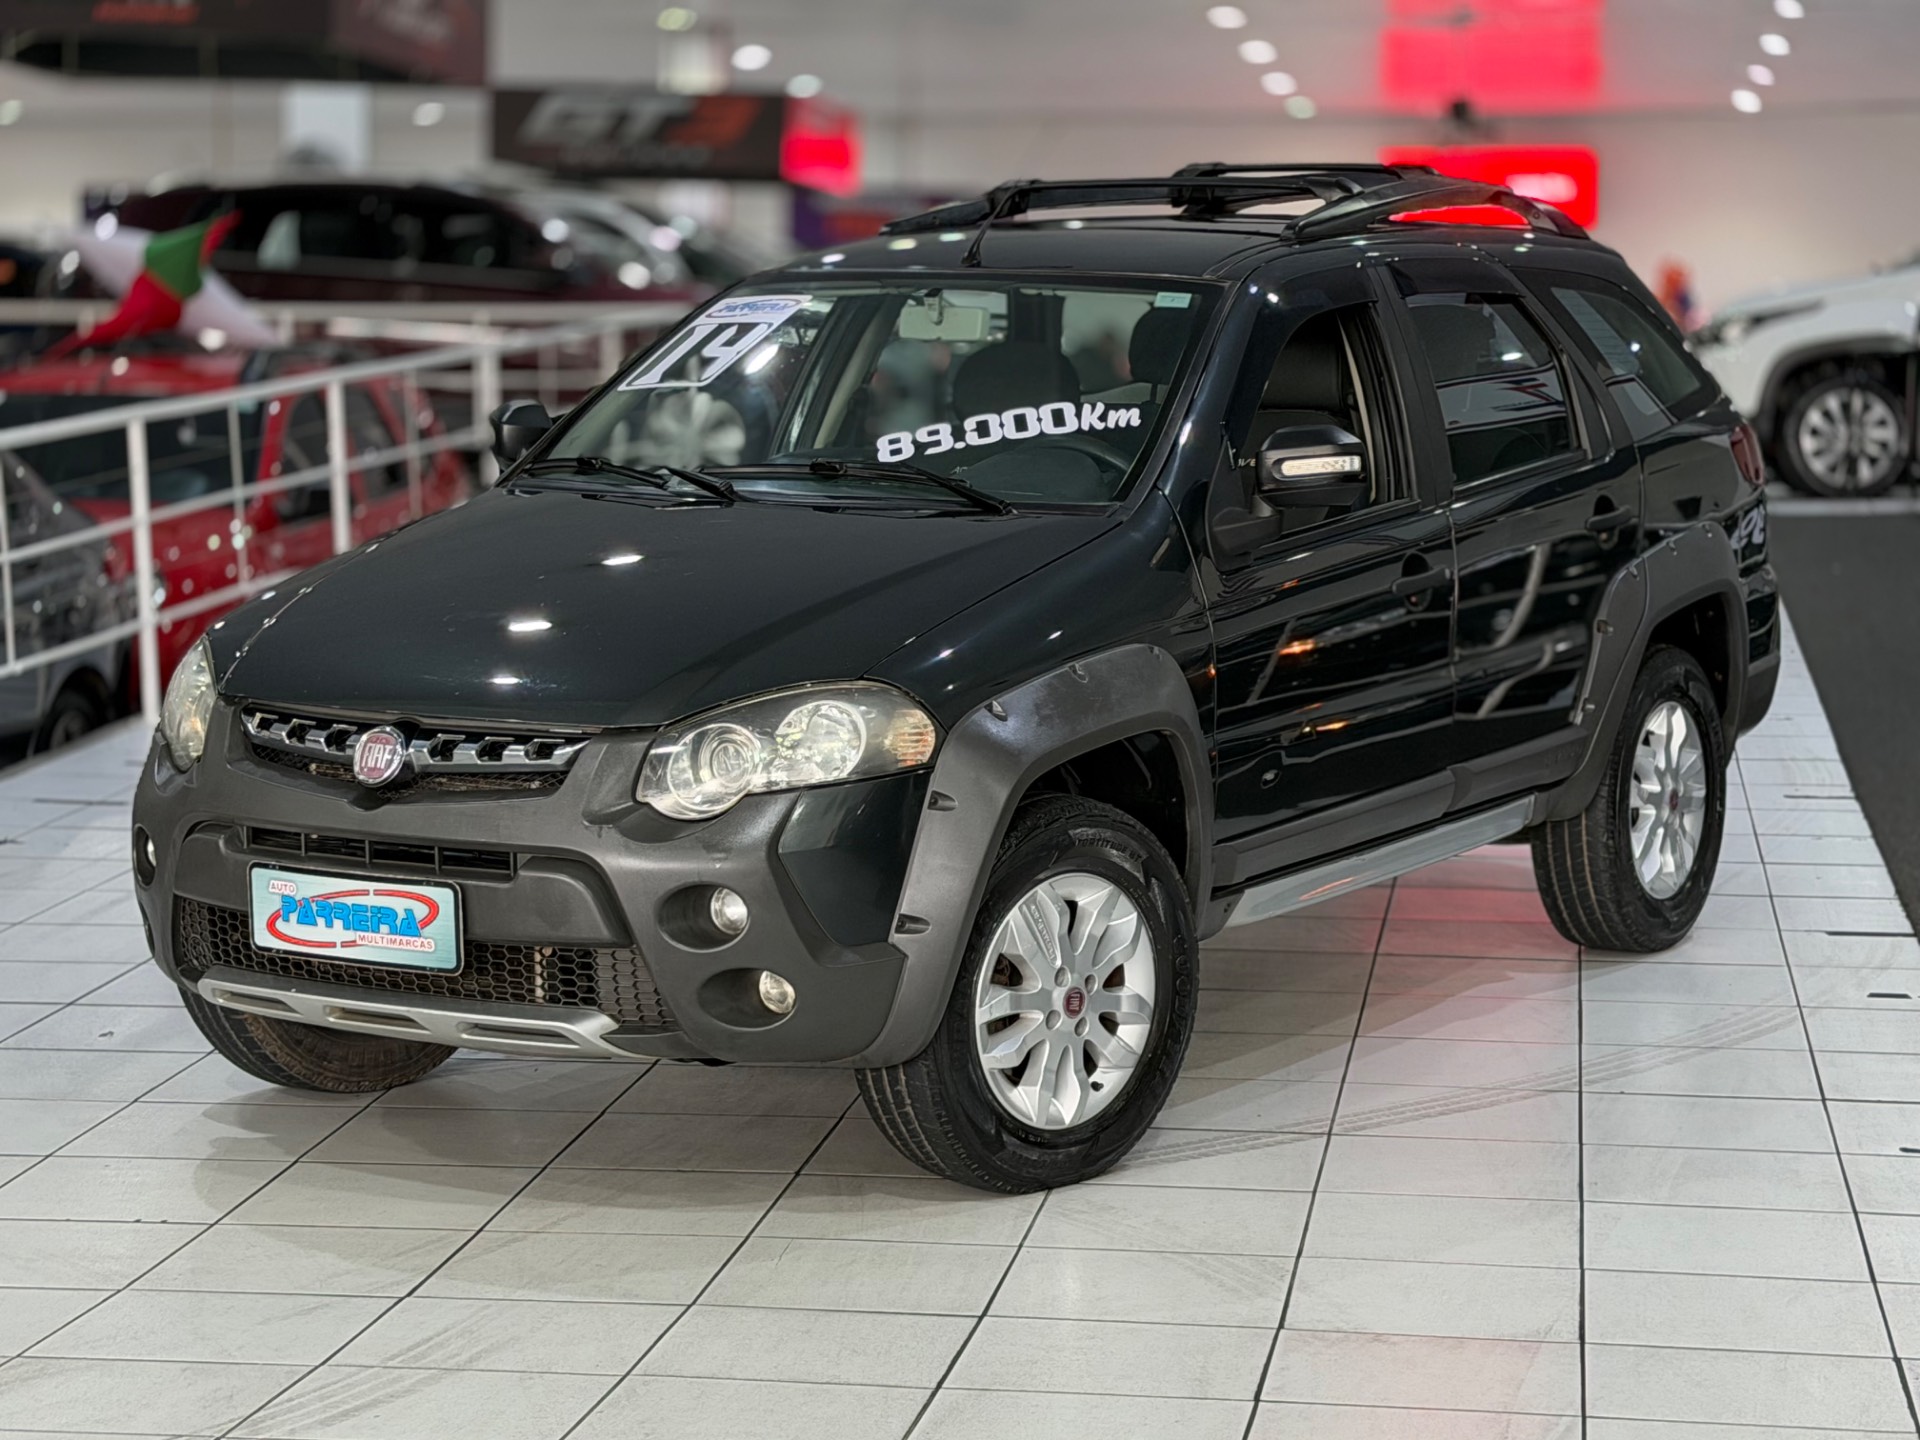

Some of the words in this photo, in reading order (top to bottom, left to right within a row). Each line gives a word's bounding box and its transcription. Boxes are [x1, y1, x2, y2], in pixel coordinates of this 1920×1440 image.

[631, 323, 769, 385] 14
[361, 743, 394, 769] FIAT
[270, 881, 296, 893] AUTO
[281, 894, 422, 938] PARREIRA
[357, 933, 434, 950] MULTIMARCAS
